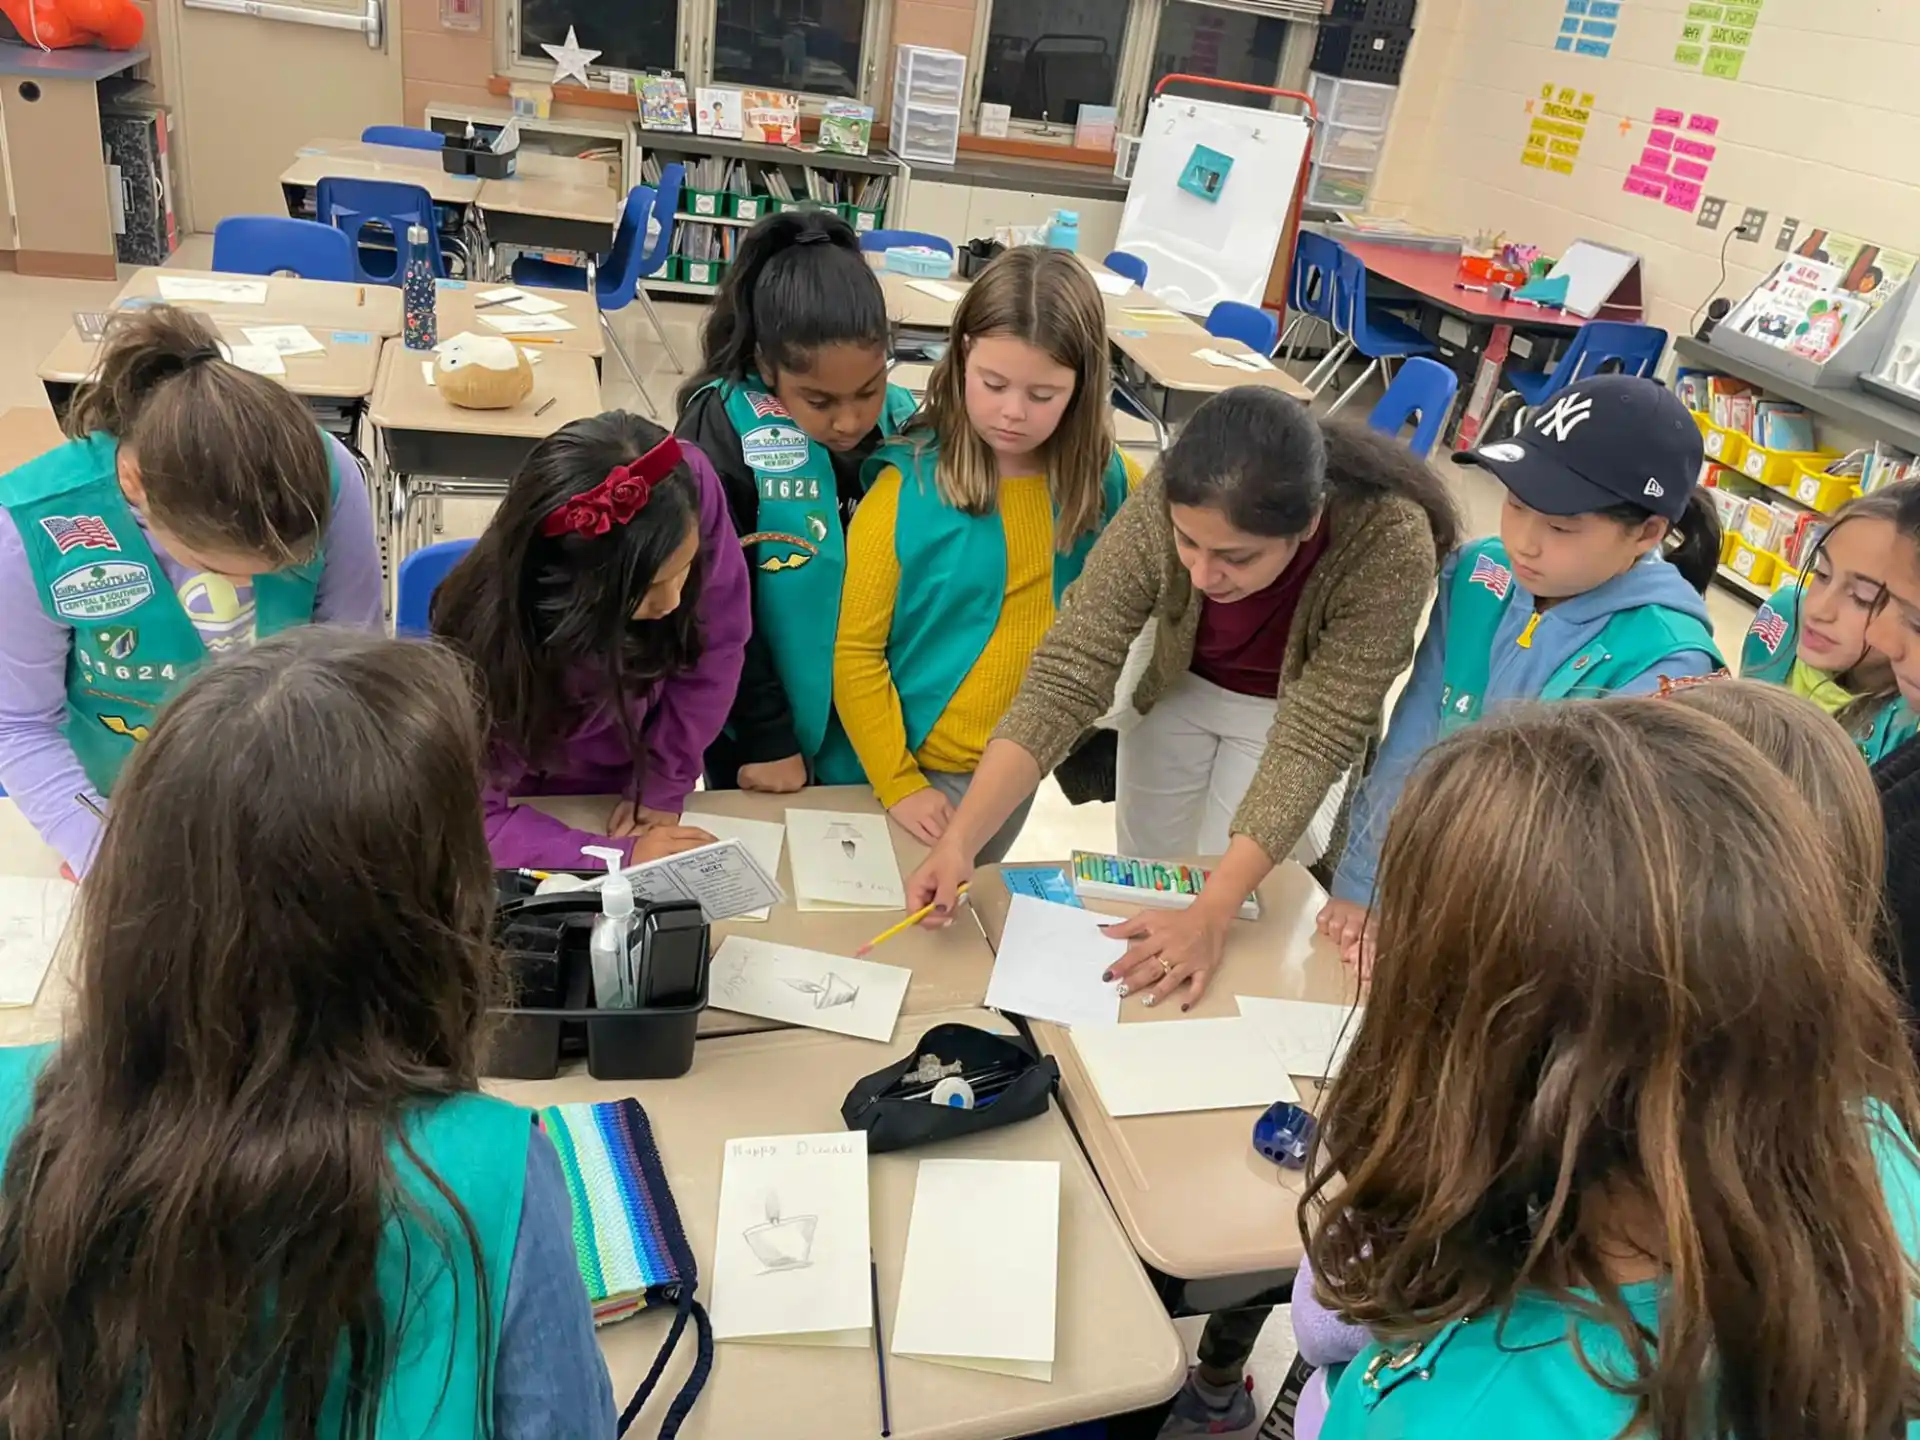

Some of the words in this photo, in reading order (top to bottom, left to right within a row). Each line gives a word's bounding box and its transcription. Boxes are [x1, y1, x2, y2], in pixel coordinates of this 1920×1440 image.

[1534, 392, 1593, 442] NY
[765, 479, 819, 498] 1624
[57, 584, 79, 596] GIRL
[80, 575, 123, 590] SCOUTS
[124, 571, 146, 583] USA
[64, 595, 98, 610] CENTRAL
[106, 586, 147, 600] SOUTHERN
[84, 602, 104, 614] NEW
[104, 597, 132, 611] JERSEY
